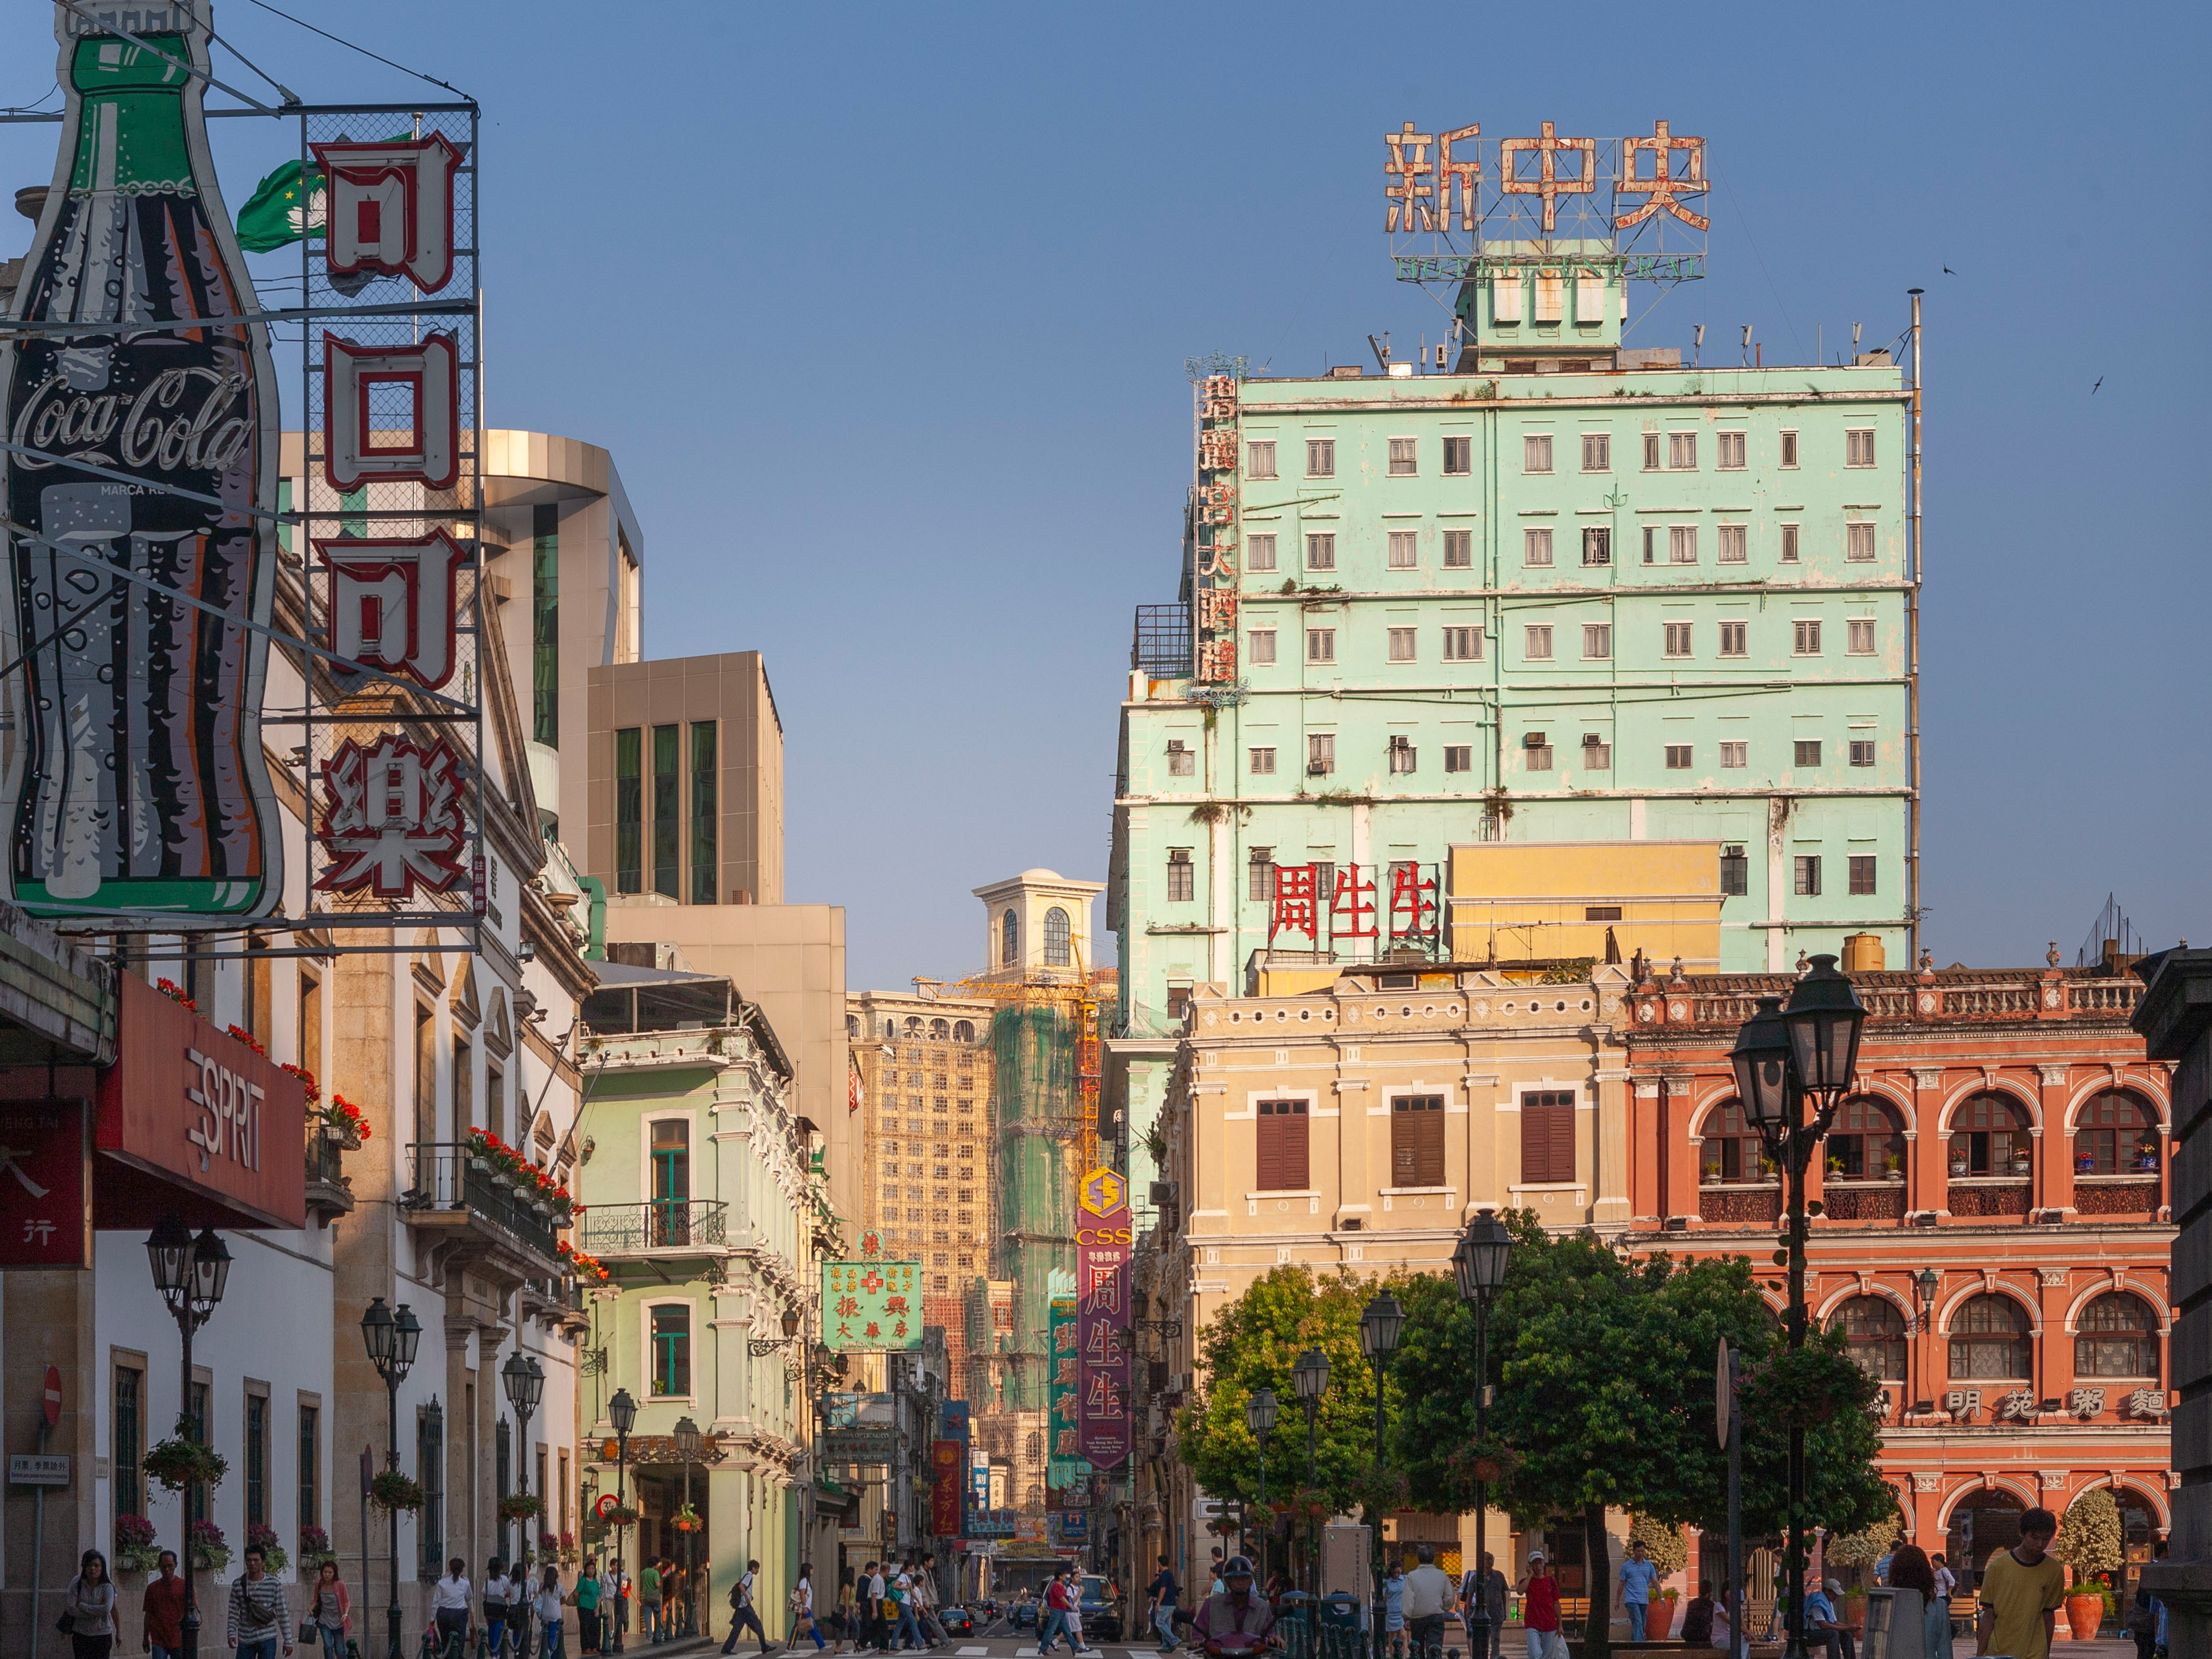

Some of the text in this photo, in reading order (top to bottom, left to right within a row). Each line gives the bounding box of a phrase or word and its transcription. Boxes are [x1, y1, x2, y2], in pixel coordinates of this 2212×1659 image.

[1385, 120, 1711, 232] 新中央
[1397, 257, 1706, 279] HOTEL CENTRAL
[101, 485, 144, 495] MARCA
[308, 130, 470, 899] 可口可樂
[1268, 862, 1441, 942] 周生生
[188, 1047, 265, 1172] ESPRIT
[23, 1219, 57, 1246] 行
[1076, 1228, 1132, 1246] CSS
[836, 1319, 909, 1339] 大藥房
[1085, 1264, 1124, 1420] 周生生
[1947, 1387, 2168, 1420] 明苑粥麵
